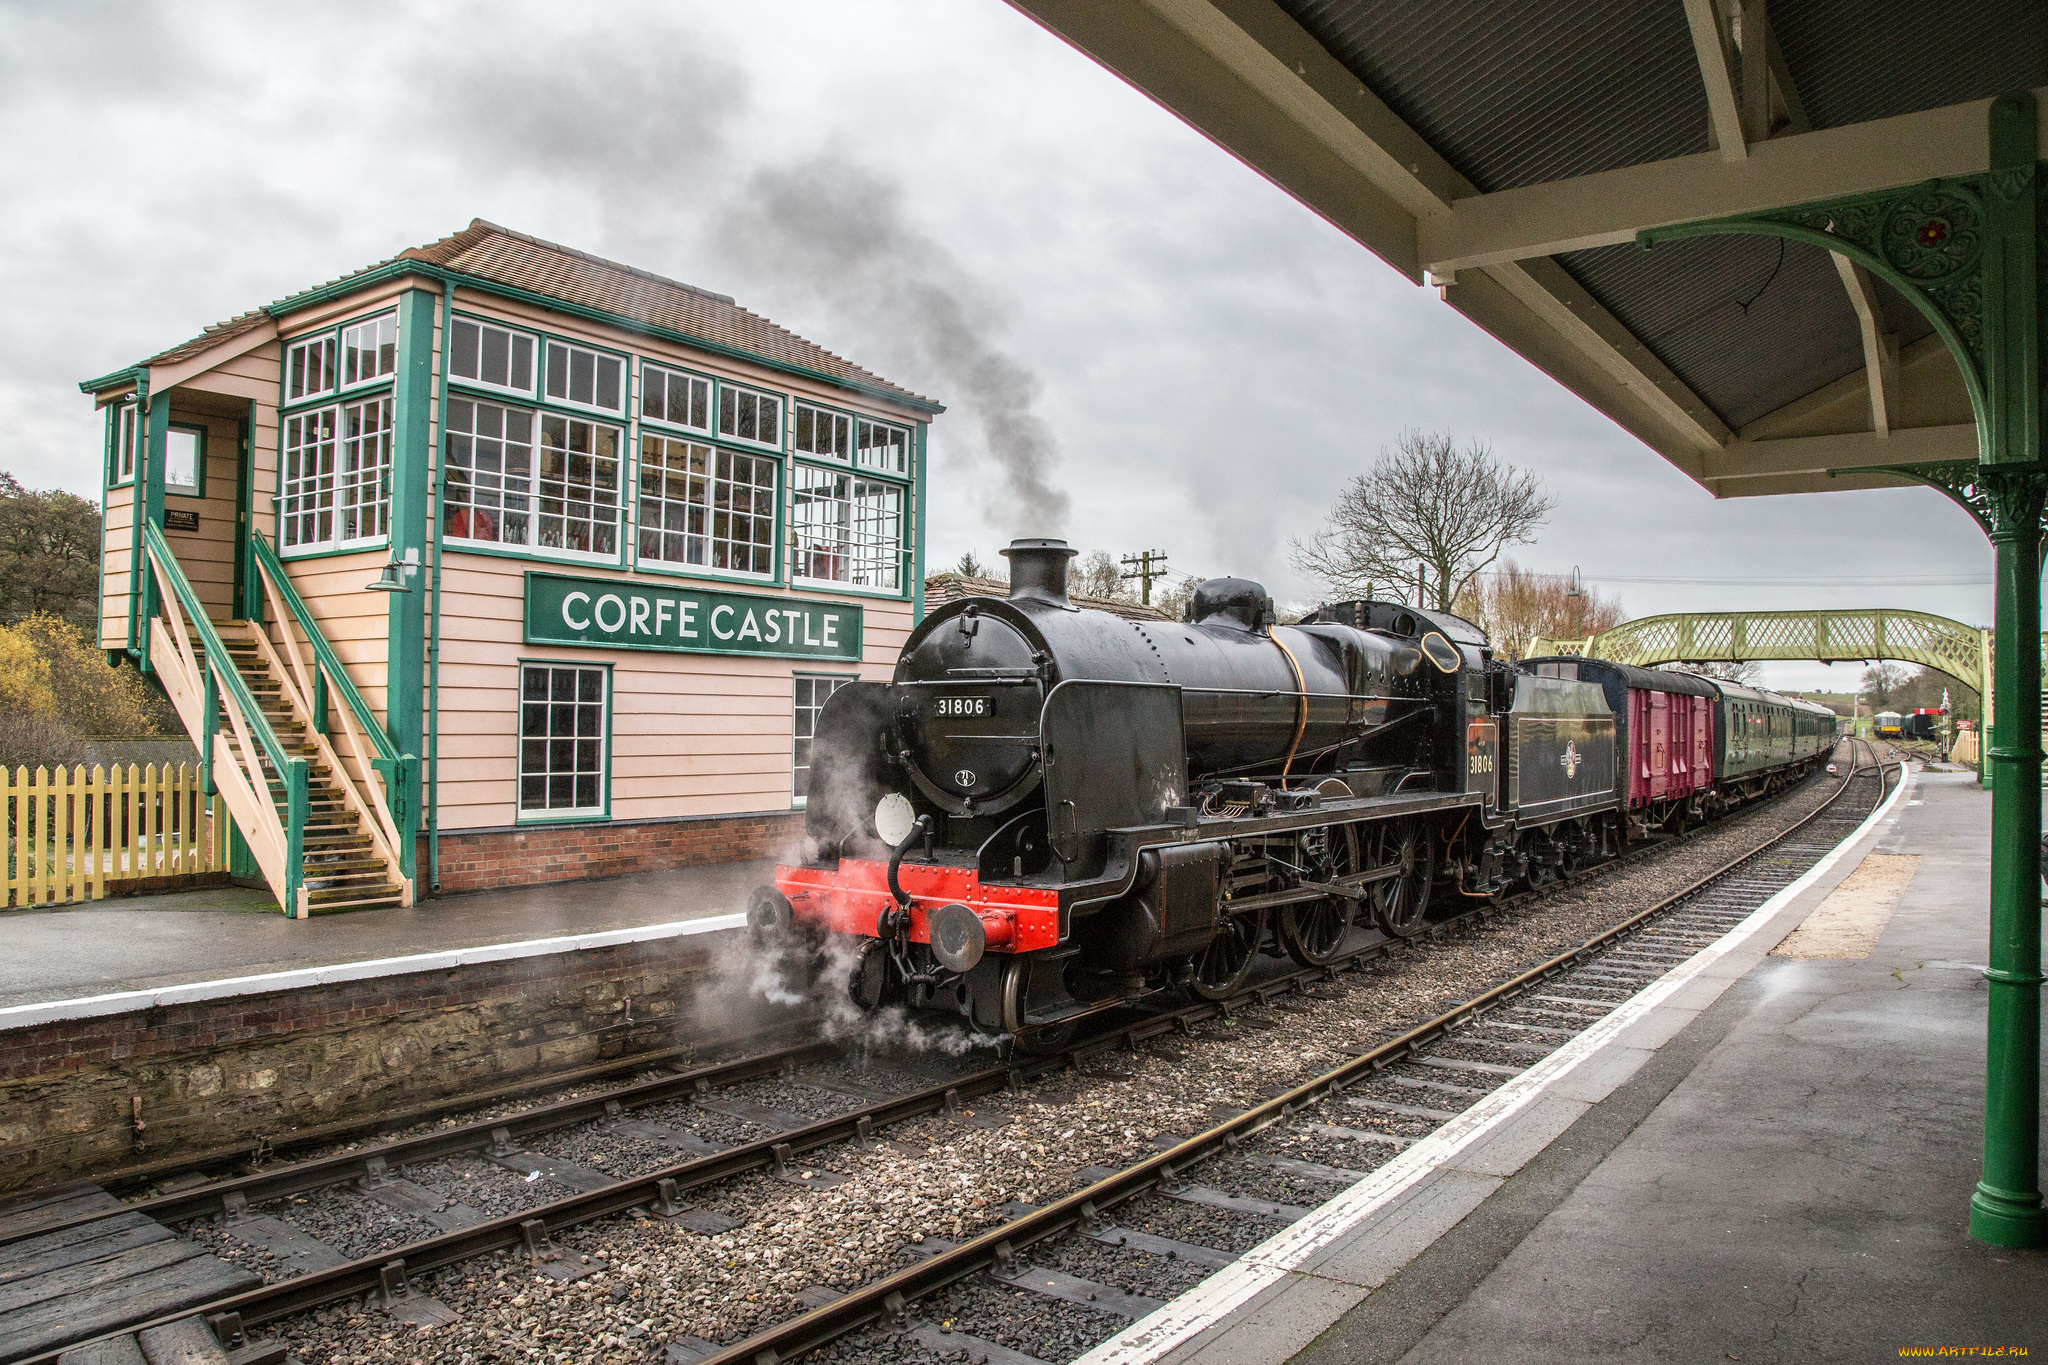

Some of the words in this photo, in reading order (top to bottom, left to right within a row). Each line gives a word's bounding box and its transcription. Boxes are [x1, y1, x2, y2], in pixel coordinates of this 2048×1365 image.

[170, 511, 194, 520] PRIVATE
[561, 591, 699, 638] CORFE
[710, 604, 840, 647] CASTLE
[938, 699, 984, 715] 31806
[1470, 754, 1493, 774] 31806
[960, 771, 969, 779] 71
